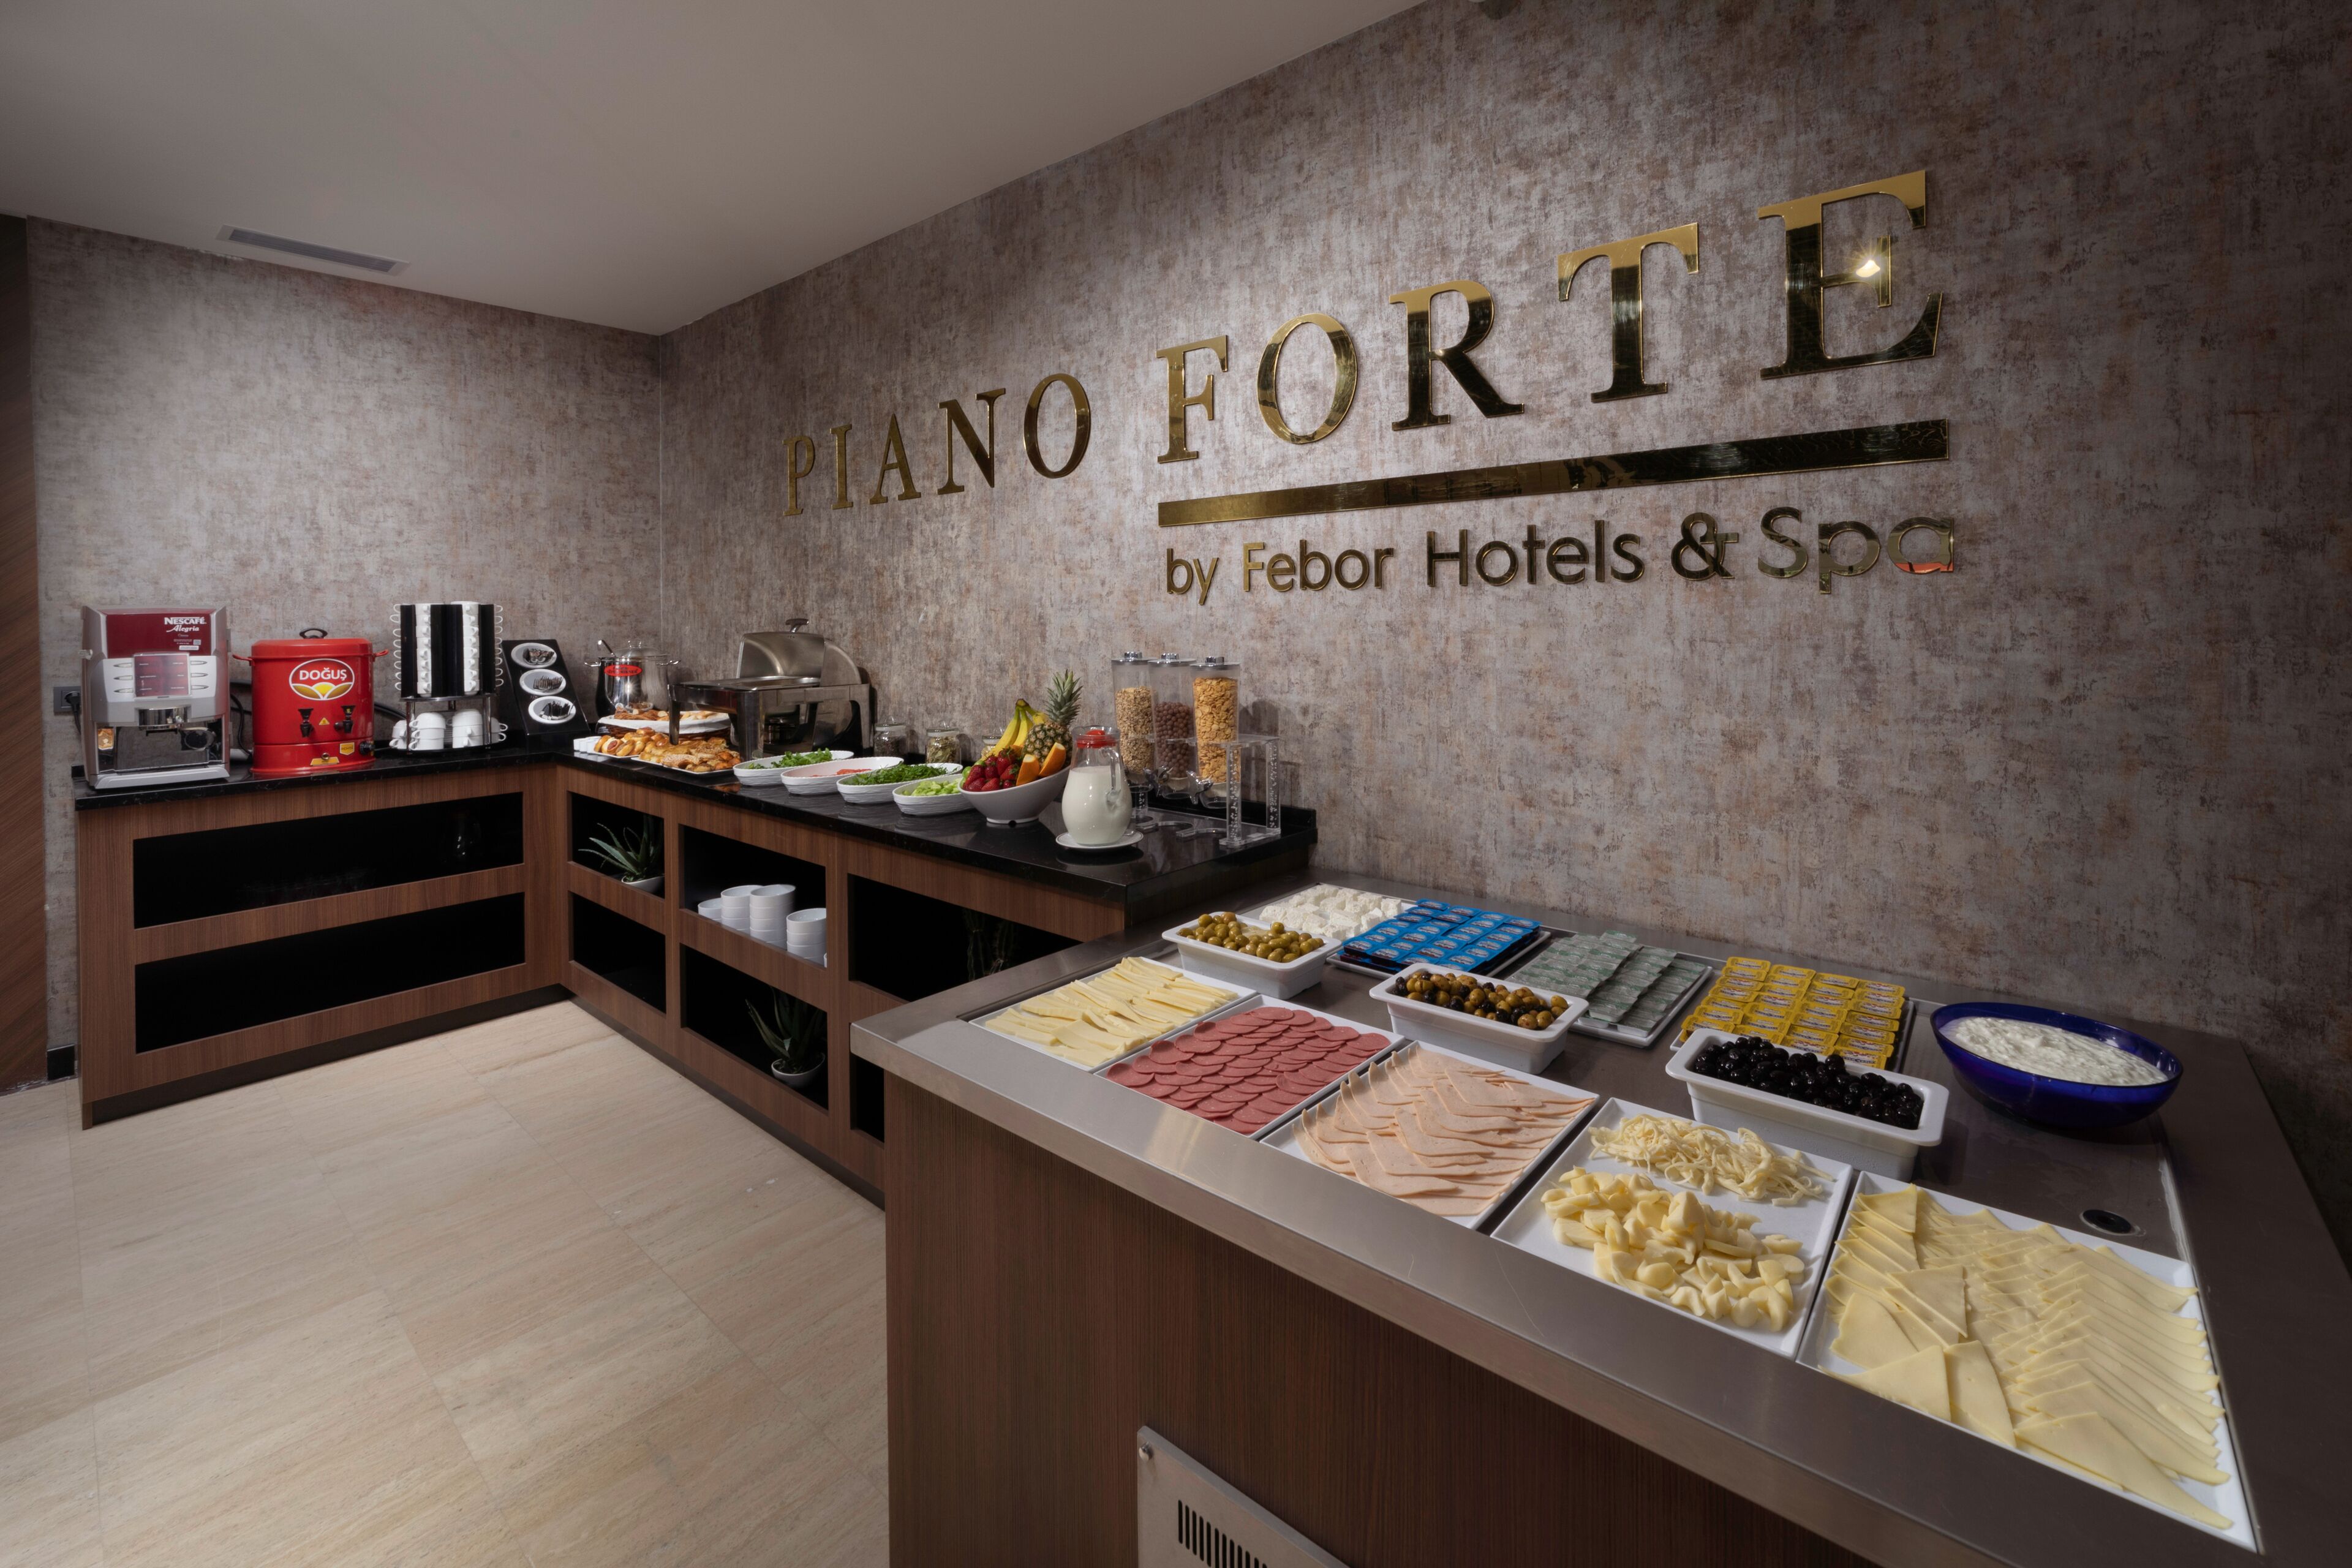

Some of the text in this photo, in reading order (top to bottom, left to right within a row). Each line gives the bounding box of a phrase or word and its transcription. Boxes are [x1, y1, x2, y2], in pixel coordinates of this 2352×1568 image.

[782, 170, 1943, 517] PIANO FORTE
[1166, 506, 1955, 605] by Febor Hotels & Spa
[166, 624, 199, 633] Alegria
[299, 667, 347, 681] DOĞUŞ
